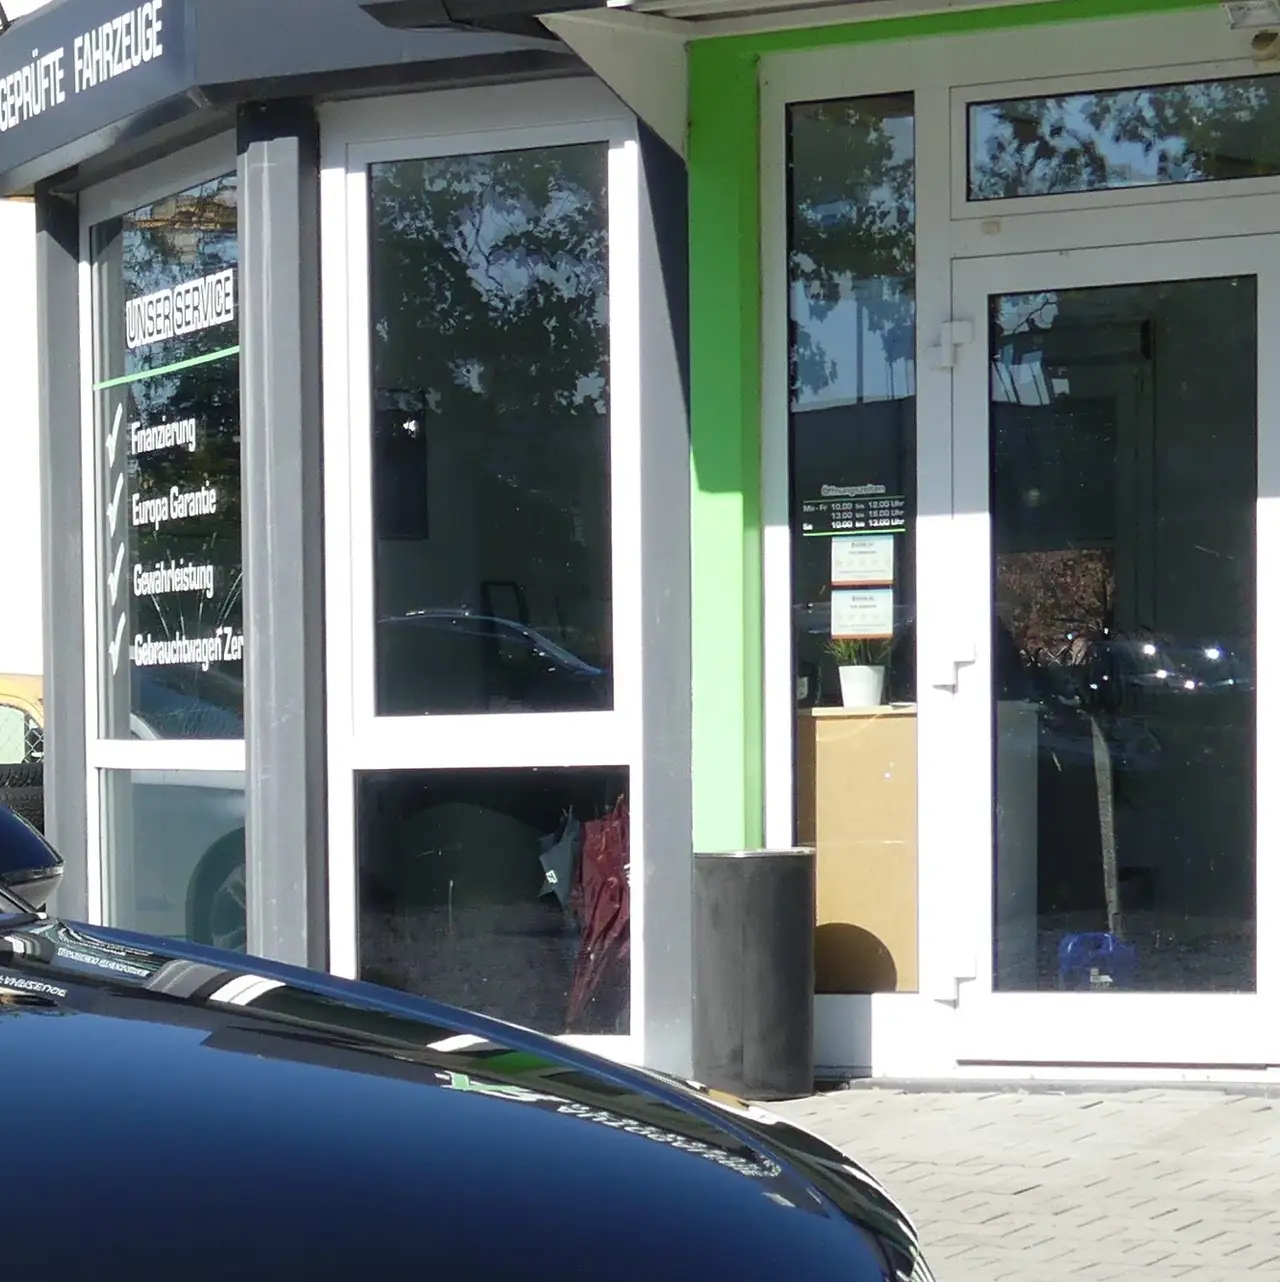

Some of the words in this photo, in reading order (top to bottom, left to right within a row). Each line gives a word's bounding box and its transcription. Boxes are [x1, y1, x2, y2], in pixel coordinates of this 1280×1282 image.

[73, 0, 163, 93] FAHRZEUGE
[125, 288, 174, 349] UNSER
[174, 268, 234, 336] SERVICE
[131, 415, 196, 455] Finanzierung
[132, 492, 169, 531] Europa
[170, 480, 217, 519] Garantie
[133, 558, 214, 599] Gewährleistung
[134, 631, 222, 672] Gebrauchtwagen
